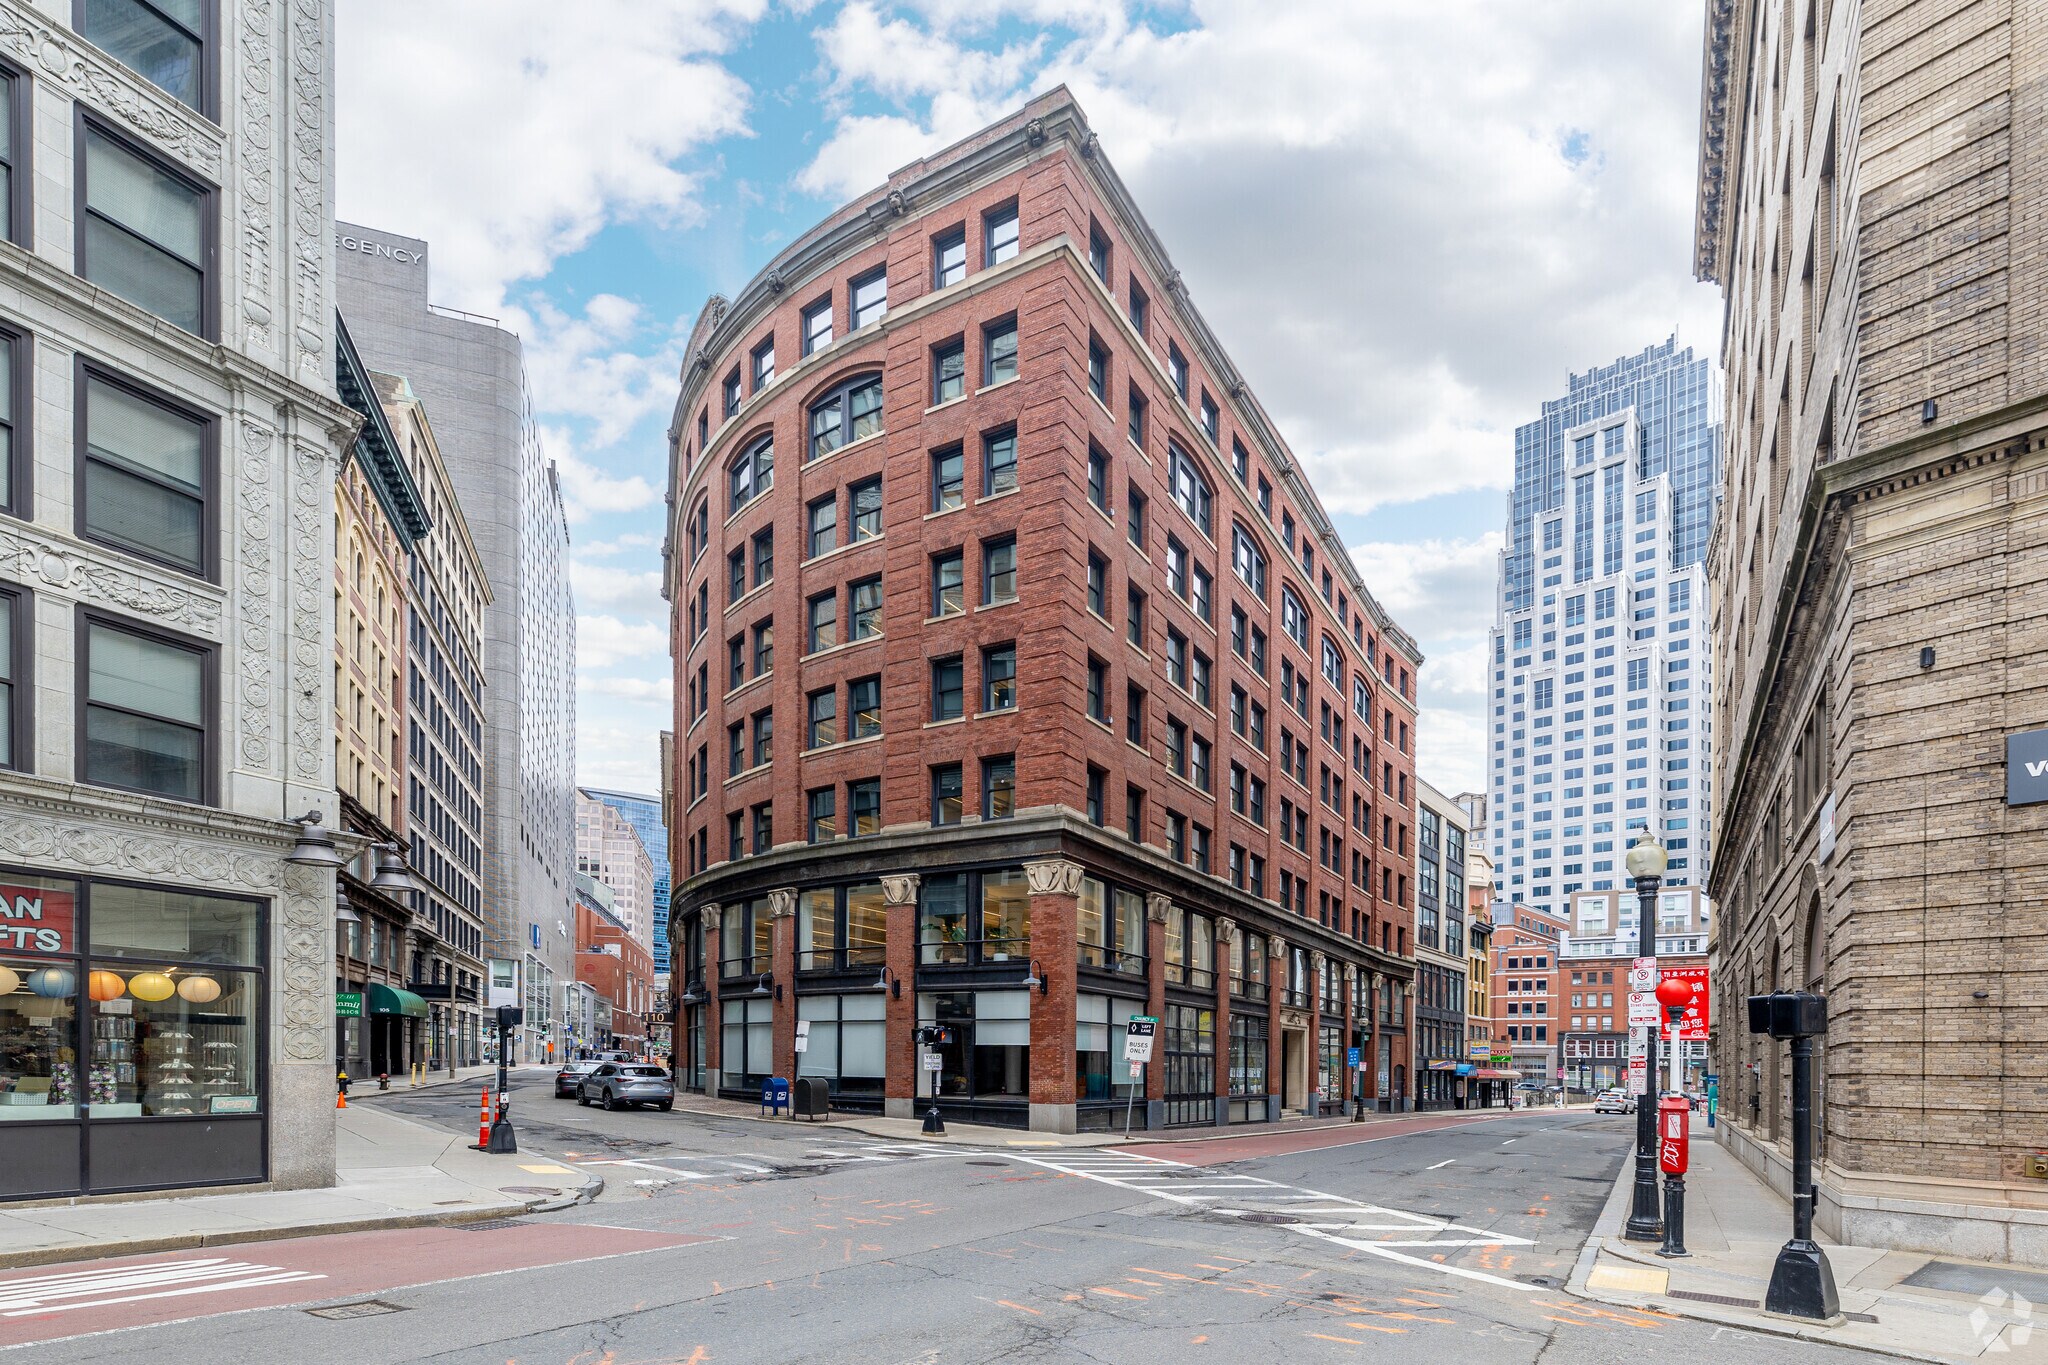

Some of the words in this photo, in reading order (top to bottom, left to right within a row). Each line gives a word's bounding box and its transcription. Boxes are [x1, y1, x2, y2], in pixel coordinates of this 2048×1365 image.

[335, 233, 423, 265] GENCY
[644, 1013, 664, 1022] 110
[215, 1100, 253, 1109] OPEN
